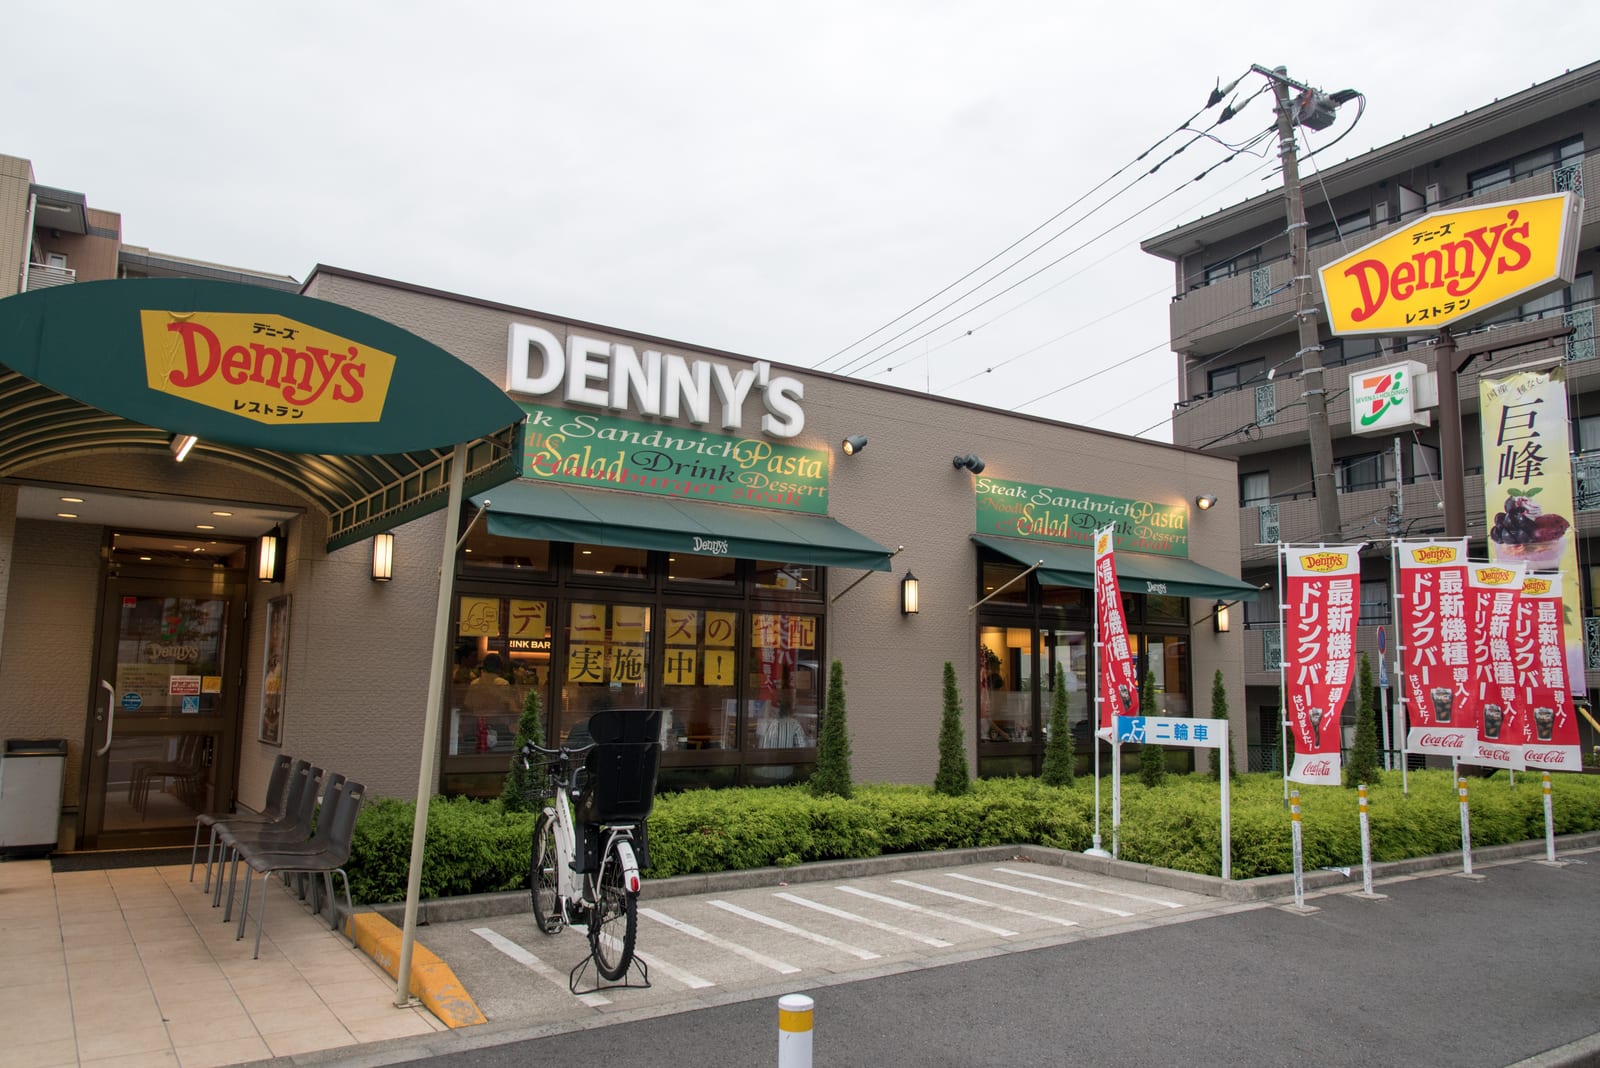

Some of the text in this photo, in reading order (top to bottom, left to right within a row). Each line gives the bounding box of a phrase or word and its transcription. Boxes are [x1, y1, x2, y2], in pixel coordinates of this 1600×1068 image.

[1412, 222, 1455, 245] デニーズ
[1344, 210, 1532, 322] Denny's
[1406, 299, 1470, 324] レストラン
[252, 322, 299, 340] デニーズ
[167, 322, 366, 406] Denny's
[506, 322, 806, 438] DENNY'S
[233, 399, 304, 418] レストラン
[559, 415, 741, 458] Sandwich
[1497, 398, 1548, 485] 巨峰
[532, 433, 626, 483] Salad
[630, 450, 735, 483] Drink
[733, 439, 823, 479] Pasta
[737, 472, 828, 498] Dessert
[976, 478, 1136, 517] Steak Sandwich
[1017, 503, 1069, 538] Salad
[1132, 500, 1184, 531] Pasta
[693, 537, 728, 555] Denny's
[1133, 526, 1187, 544] Dessert
[1305, 554, 1343, 571] Denny's
[1418, 547, 1453, 563] Denny's
[1480, 570, 1510, 583] Denny's
[531, 641, 551, 649] BAR
[1296, 581, 1323, 706] ドリンクバー
[1412, 572, 1437, 685] ドリンクバー
[1474, 592, 1493, 700] ドリンクバー
[1515, 602, 1538, 705] ドリンクバー
[1156, 723, 1209, 742] 二輪車
